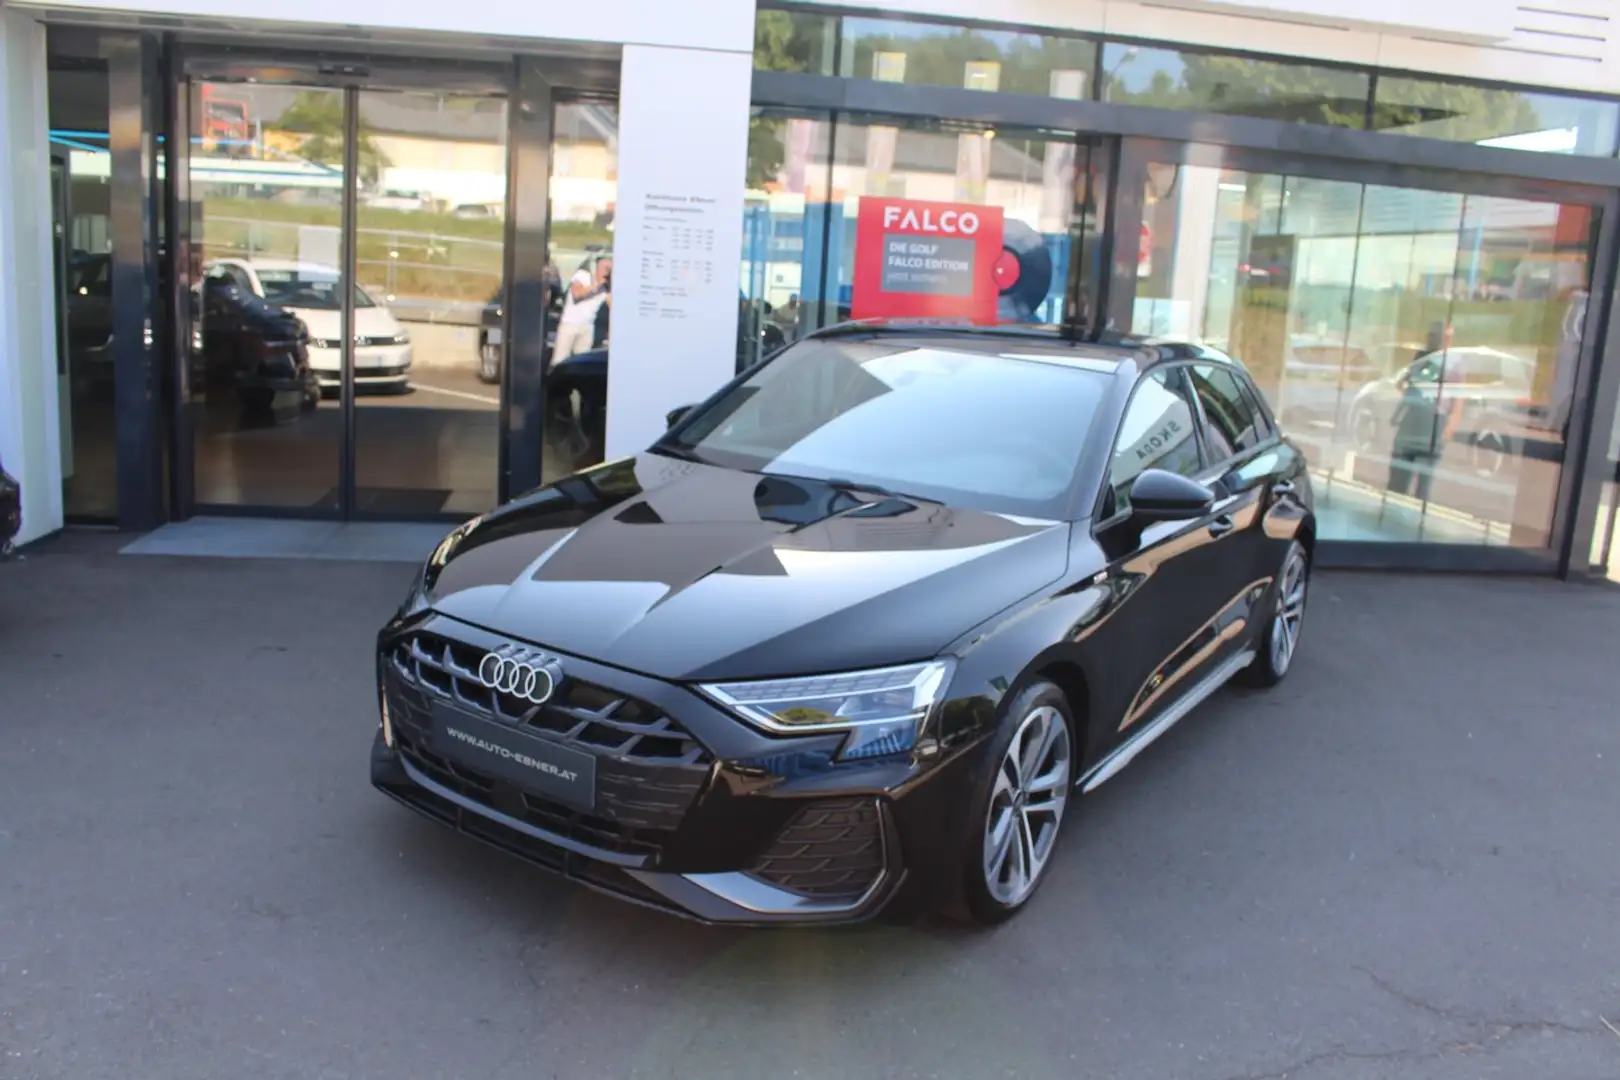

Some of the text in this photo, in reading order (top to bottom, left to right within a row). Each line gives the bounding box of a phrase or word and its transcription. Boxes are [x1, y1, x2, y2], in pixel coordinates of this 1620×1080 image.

[884, 205, 979, 234] FALCO
[889, 241, 939, 255] DIE GOLF
[888, 255, 969, 272] FALCO EDITION
[446, 727, 578, 783] WWW.AUTO-EBNER.AT
